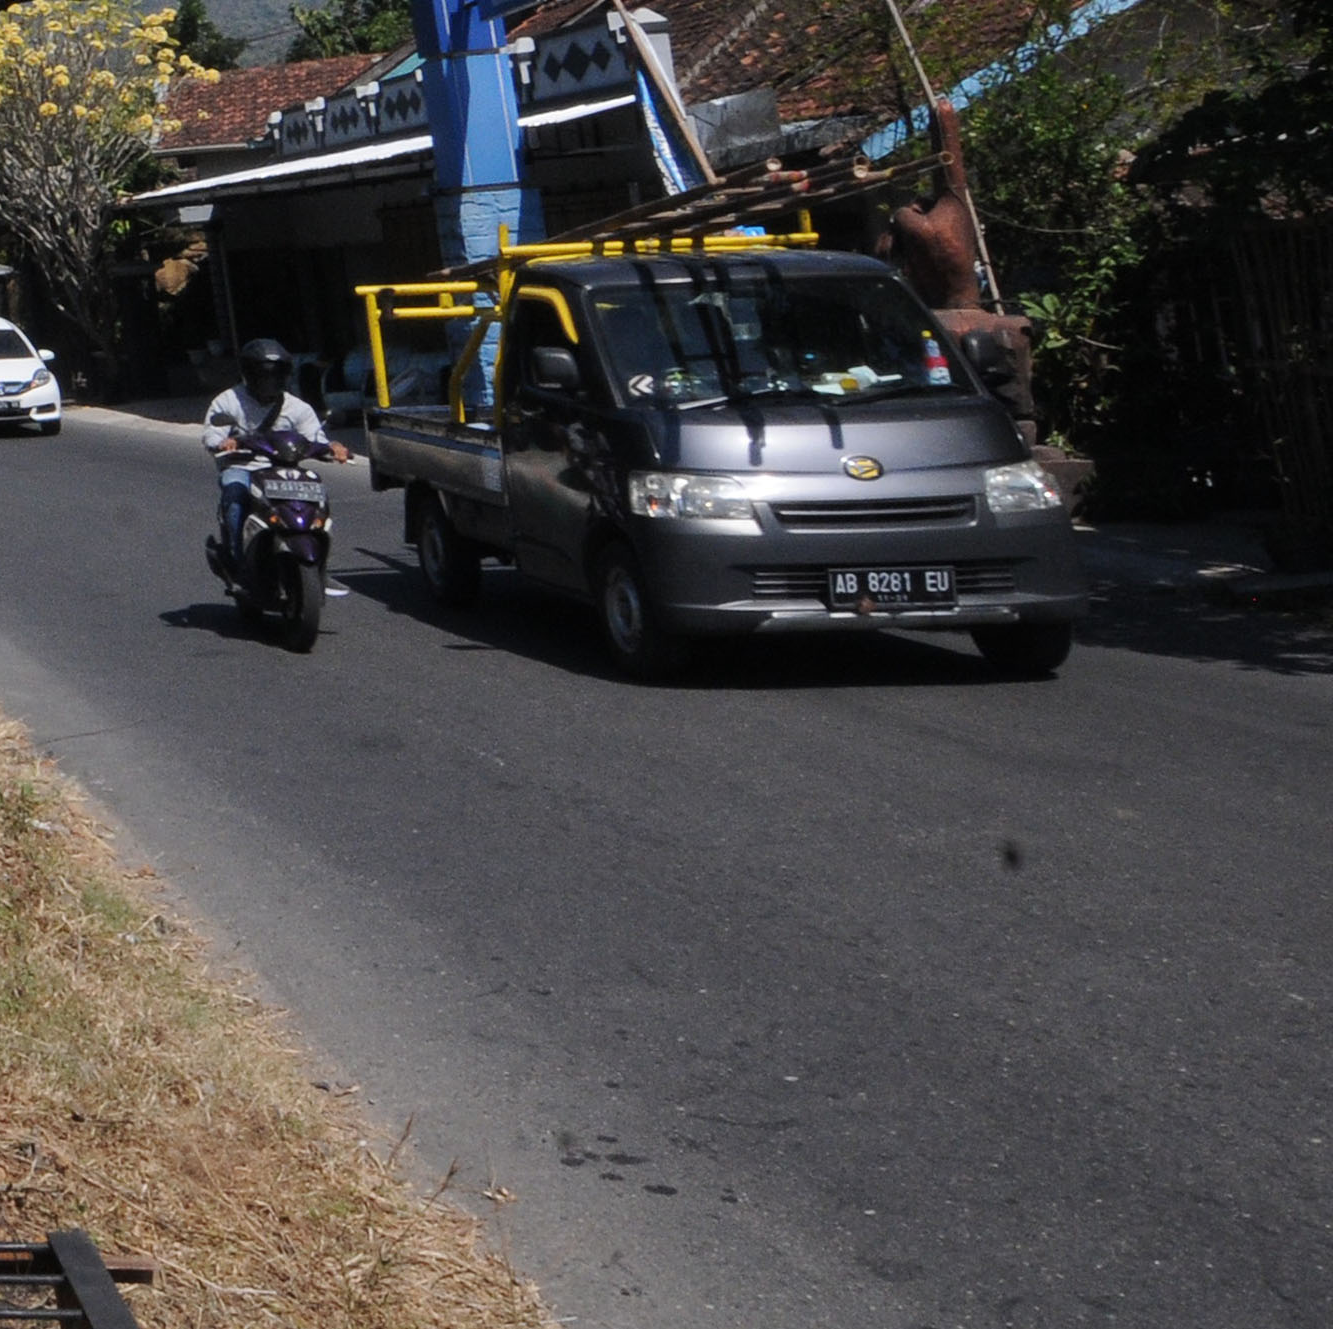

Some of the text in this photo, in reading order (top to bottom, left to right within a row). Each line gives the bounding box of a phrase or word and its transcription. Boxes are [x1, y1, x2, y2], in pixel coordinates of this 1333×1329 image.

[835, 571, 949, 593] AB 8281 EU
